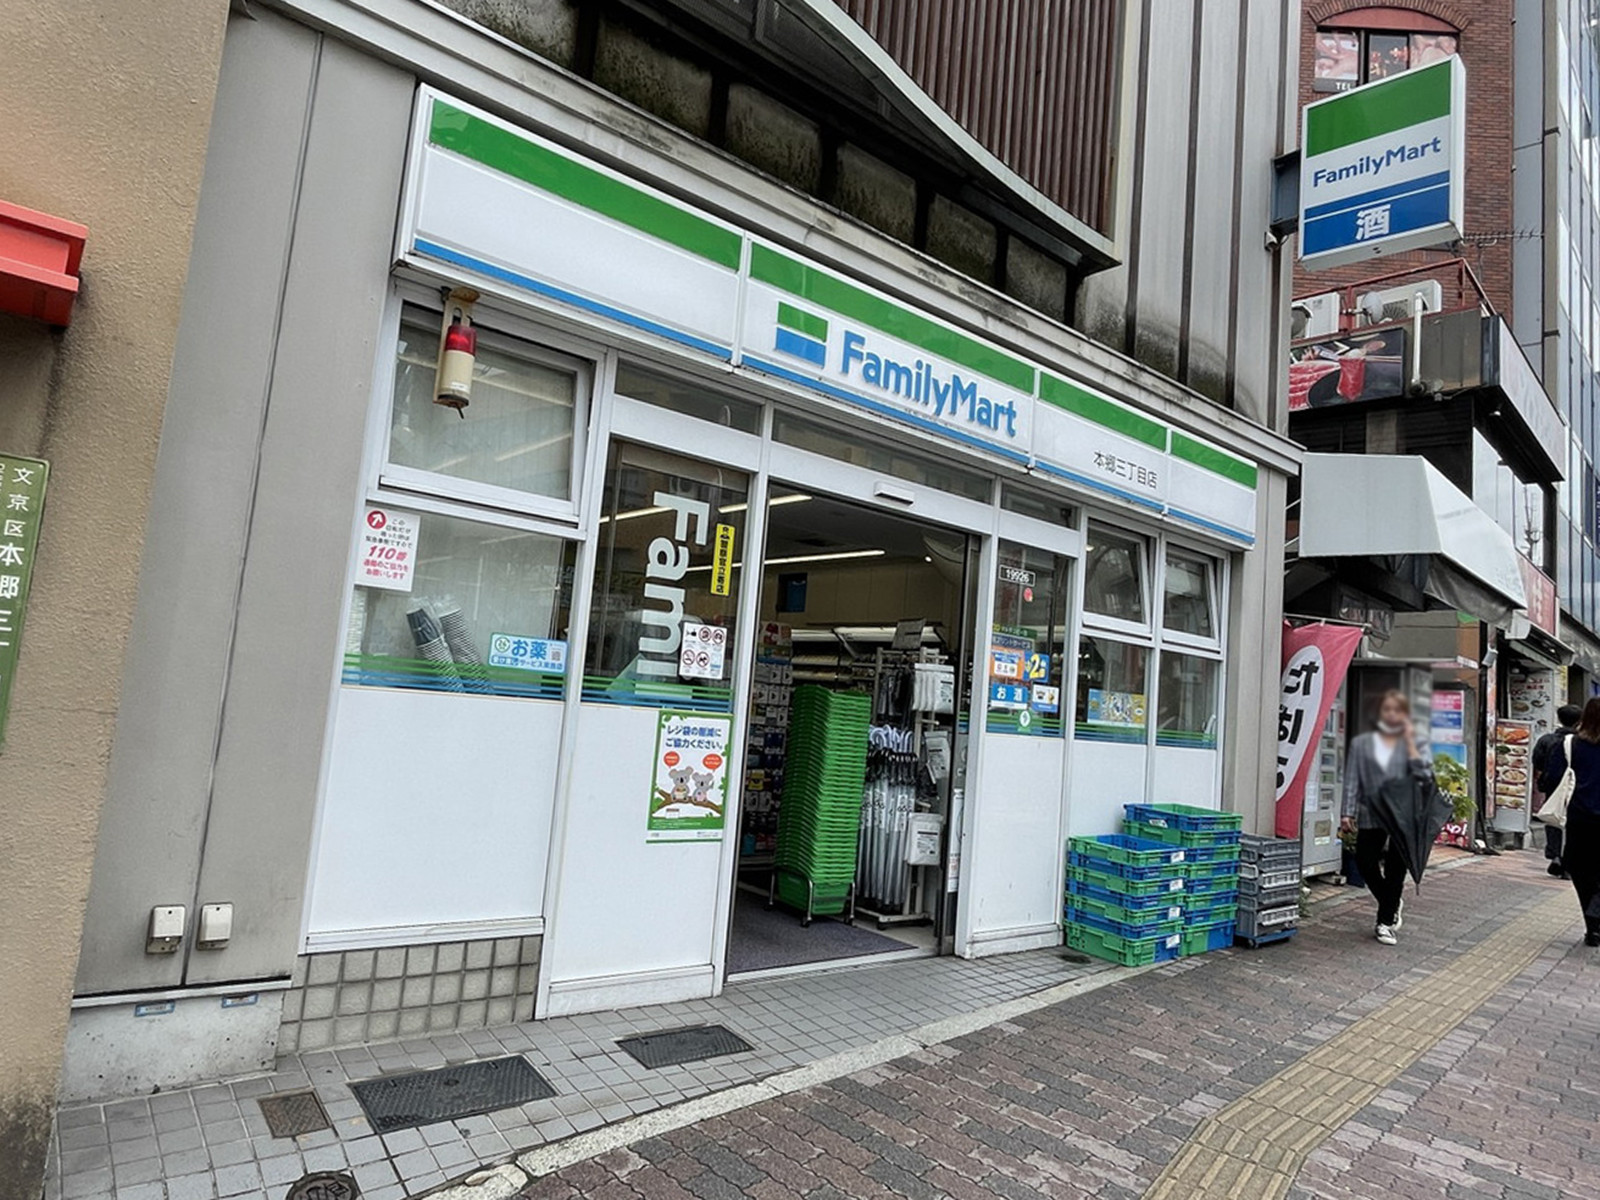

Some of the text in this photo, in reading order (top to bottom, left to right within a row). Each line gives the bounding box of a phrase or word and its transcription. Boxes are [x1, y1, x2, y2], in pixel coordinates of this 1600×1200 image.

[1313, 136, 1441, 187] FamilyMart
[1355, 203, 1391, 240] 酒
[842, 330, 1016, 437] FamilyMart
[1093, 451, 1157, 489] 本郷三丁目店
[511, 639, 548, 660] お薬
[667, 725, 722, 737] レジ袋の削減に
